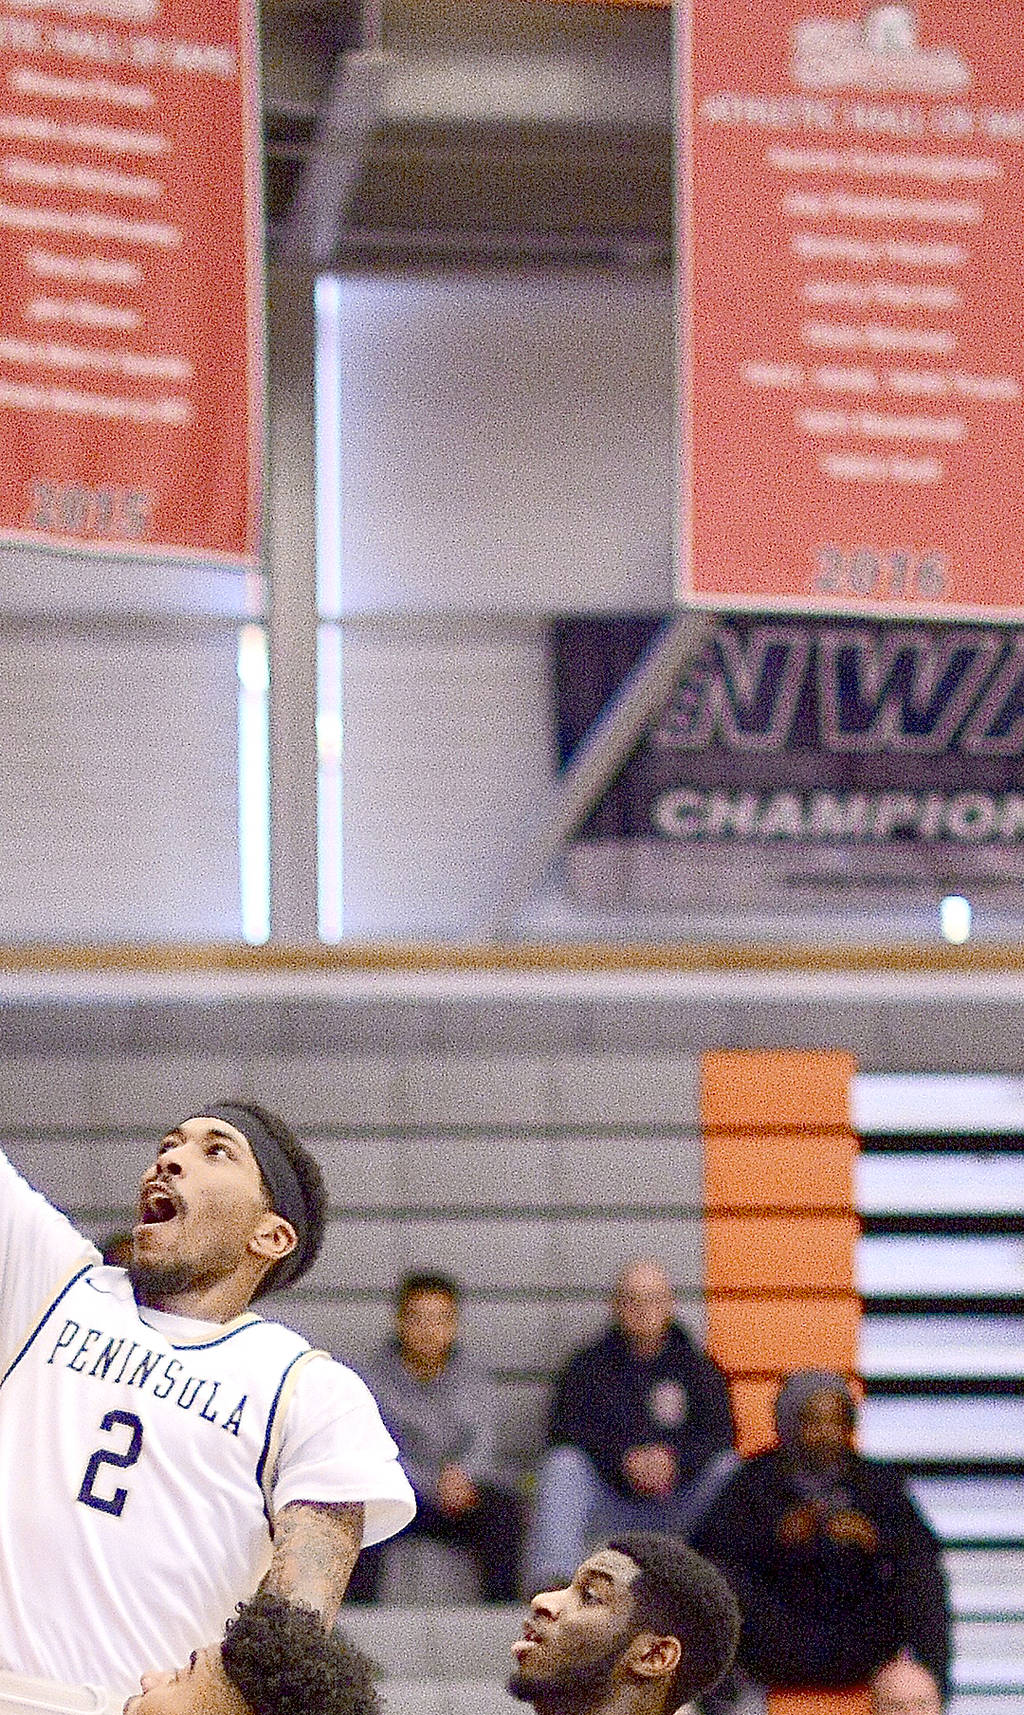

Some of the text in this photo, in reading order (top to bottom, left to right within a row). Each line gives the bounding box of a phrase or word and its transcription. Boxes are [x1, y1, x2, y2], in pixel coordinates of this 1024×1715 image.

[812, 544, 950, 600] 2016
[47, 1319, 250, 1437] PENINSULA
[76, 1409, 144, 1518] 2
